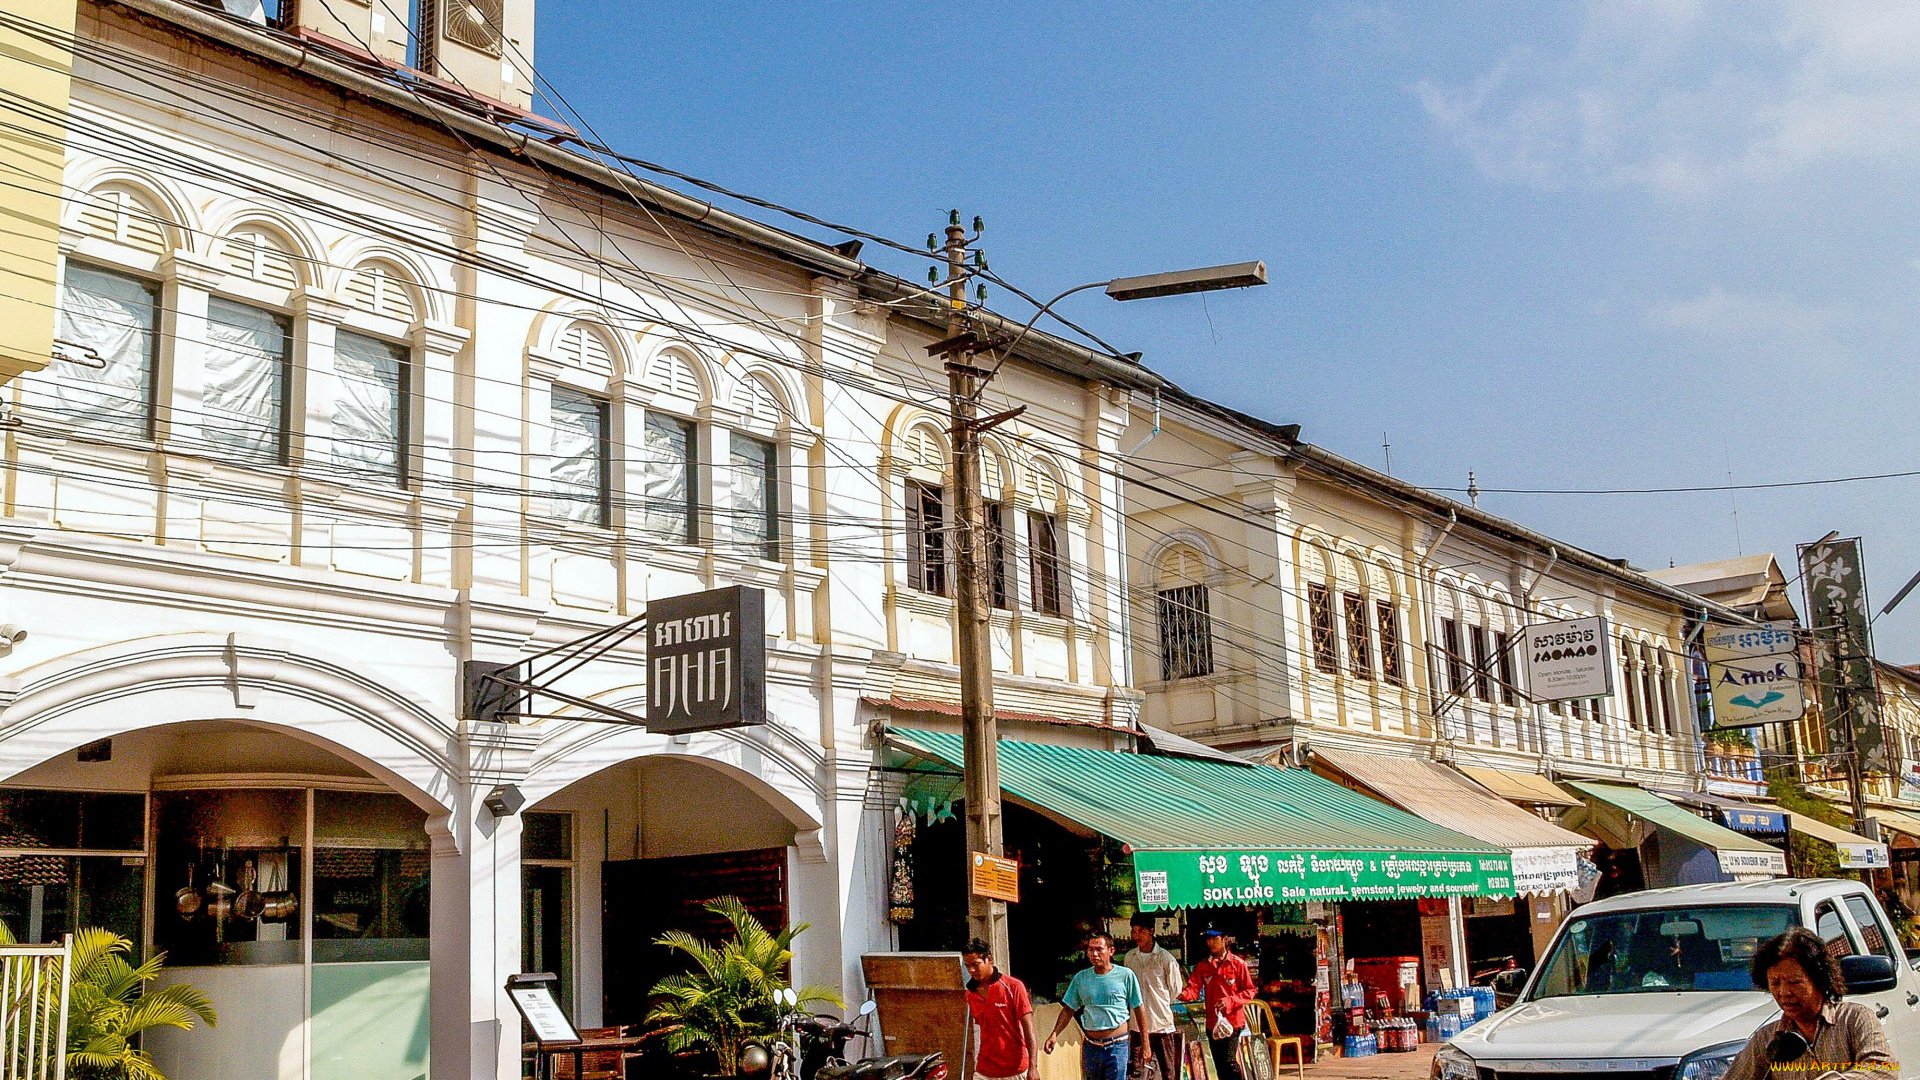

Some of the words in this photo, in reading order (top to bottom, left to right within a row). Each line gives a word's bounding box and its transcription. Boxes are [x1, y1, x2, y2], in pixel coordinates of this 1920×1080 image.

[654, 647, 731, 718] AHA
[1716, 662, 1790, 689] Amok
[1203, 887, 1234, 901] SOK
[1236, 886, 1274, 900] LONG
[1281, 885, 1306, 898] Sale
[1351, 884, 1395, 898] gemstone
[1429, 883, 1445, 893] and
[1445, 882, 1480, 893] souvenir
